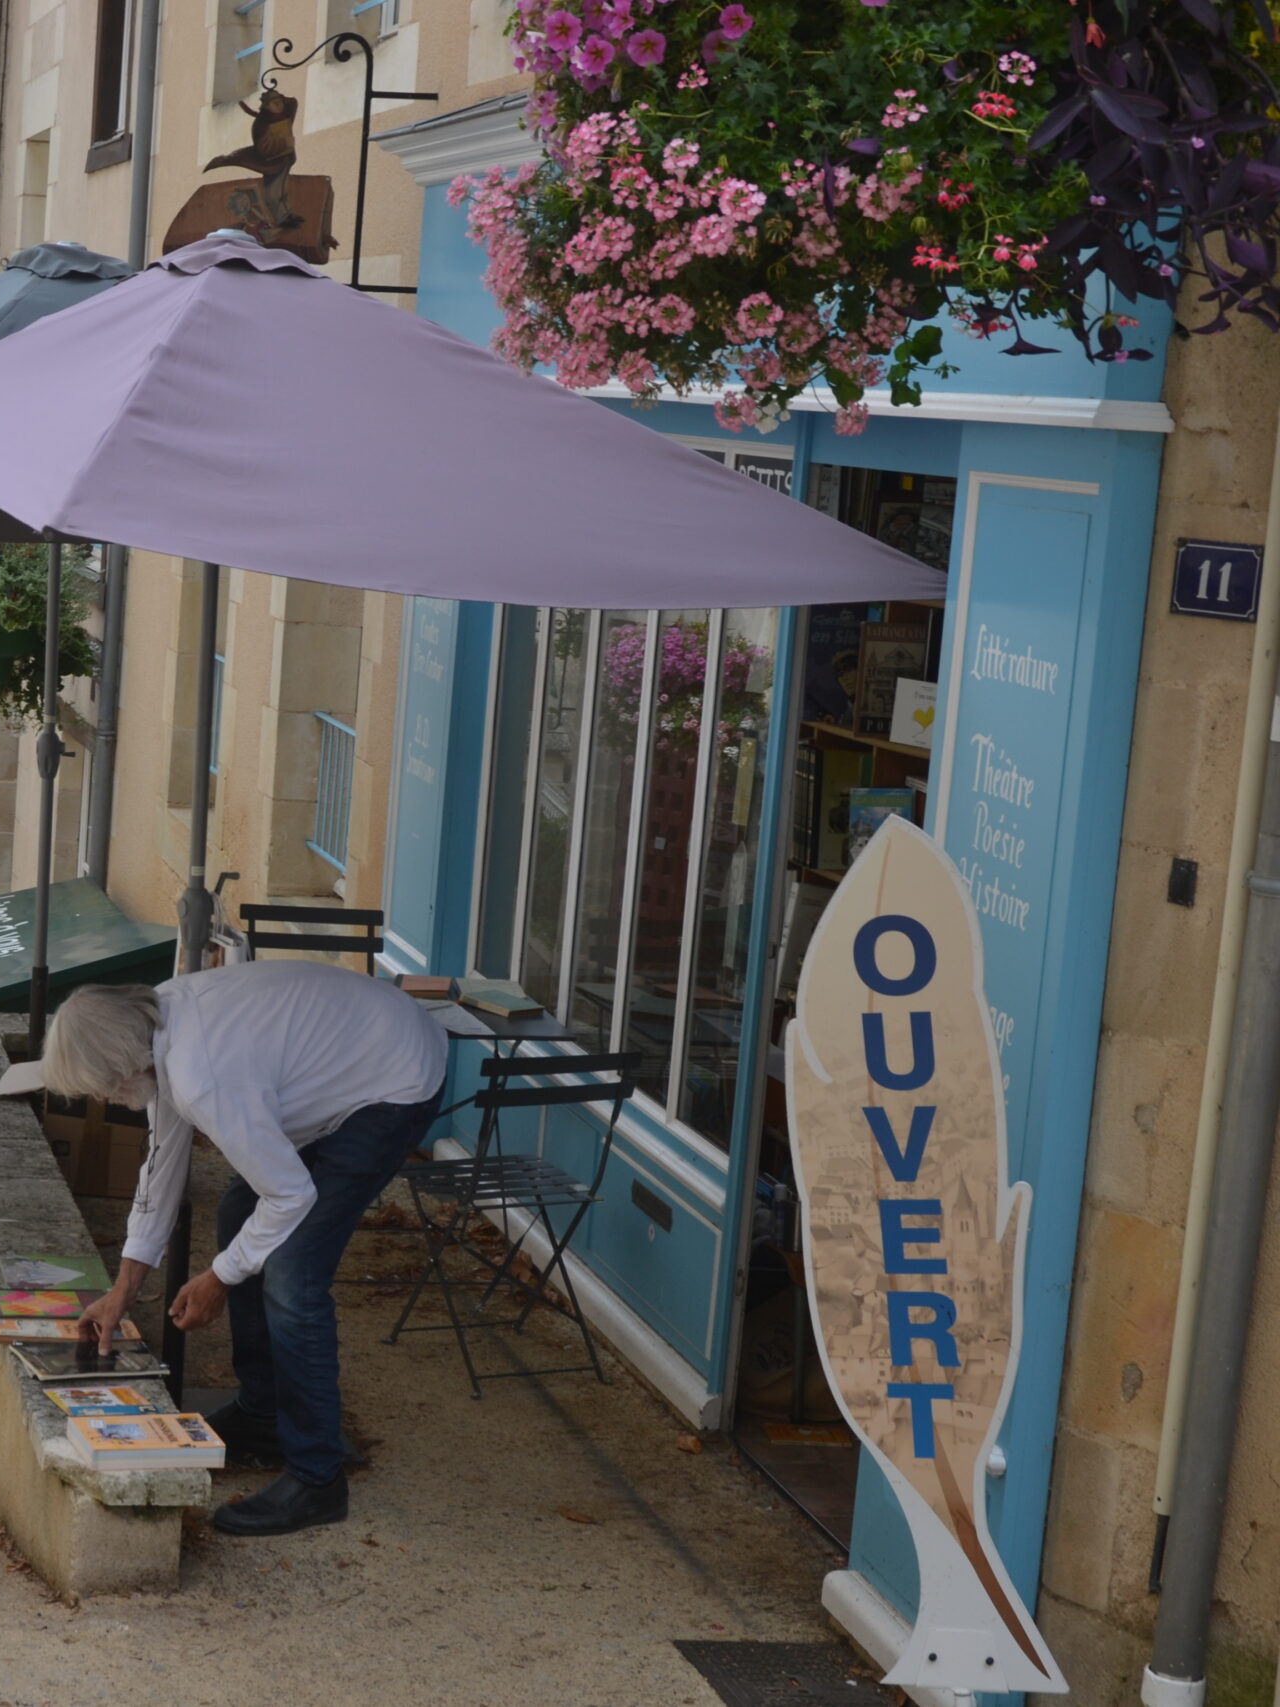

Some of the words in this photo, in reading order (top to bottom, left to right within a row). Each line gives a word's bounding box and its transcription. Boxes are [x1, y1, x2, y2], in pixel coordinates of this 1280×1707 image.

[1196, 559, 1232, 602] 11
[970, 623, 1059, 695] Littérature
[969, 733, 1034, 808] Théâtre
[972, 801, 1025, 869] Poésie
[960, 857, 1030, 931] Histoire
[853, 914, 962, 1459] OUVERT
